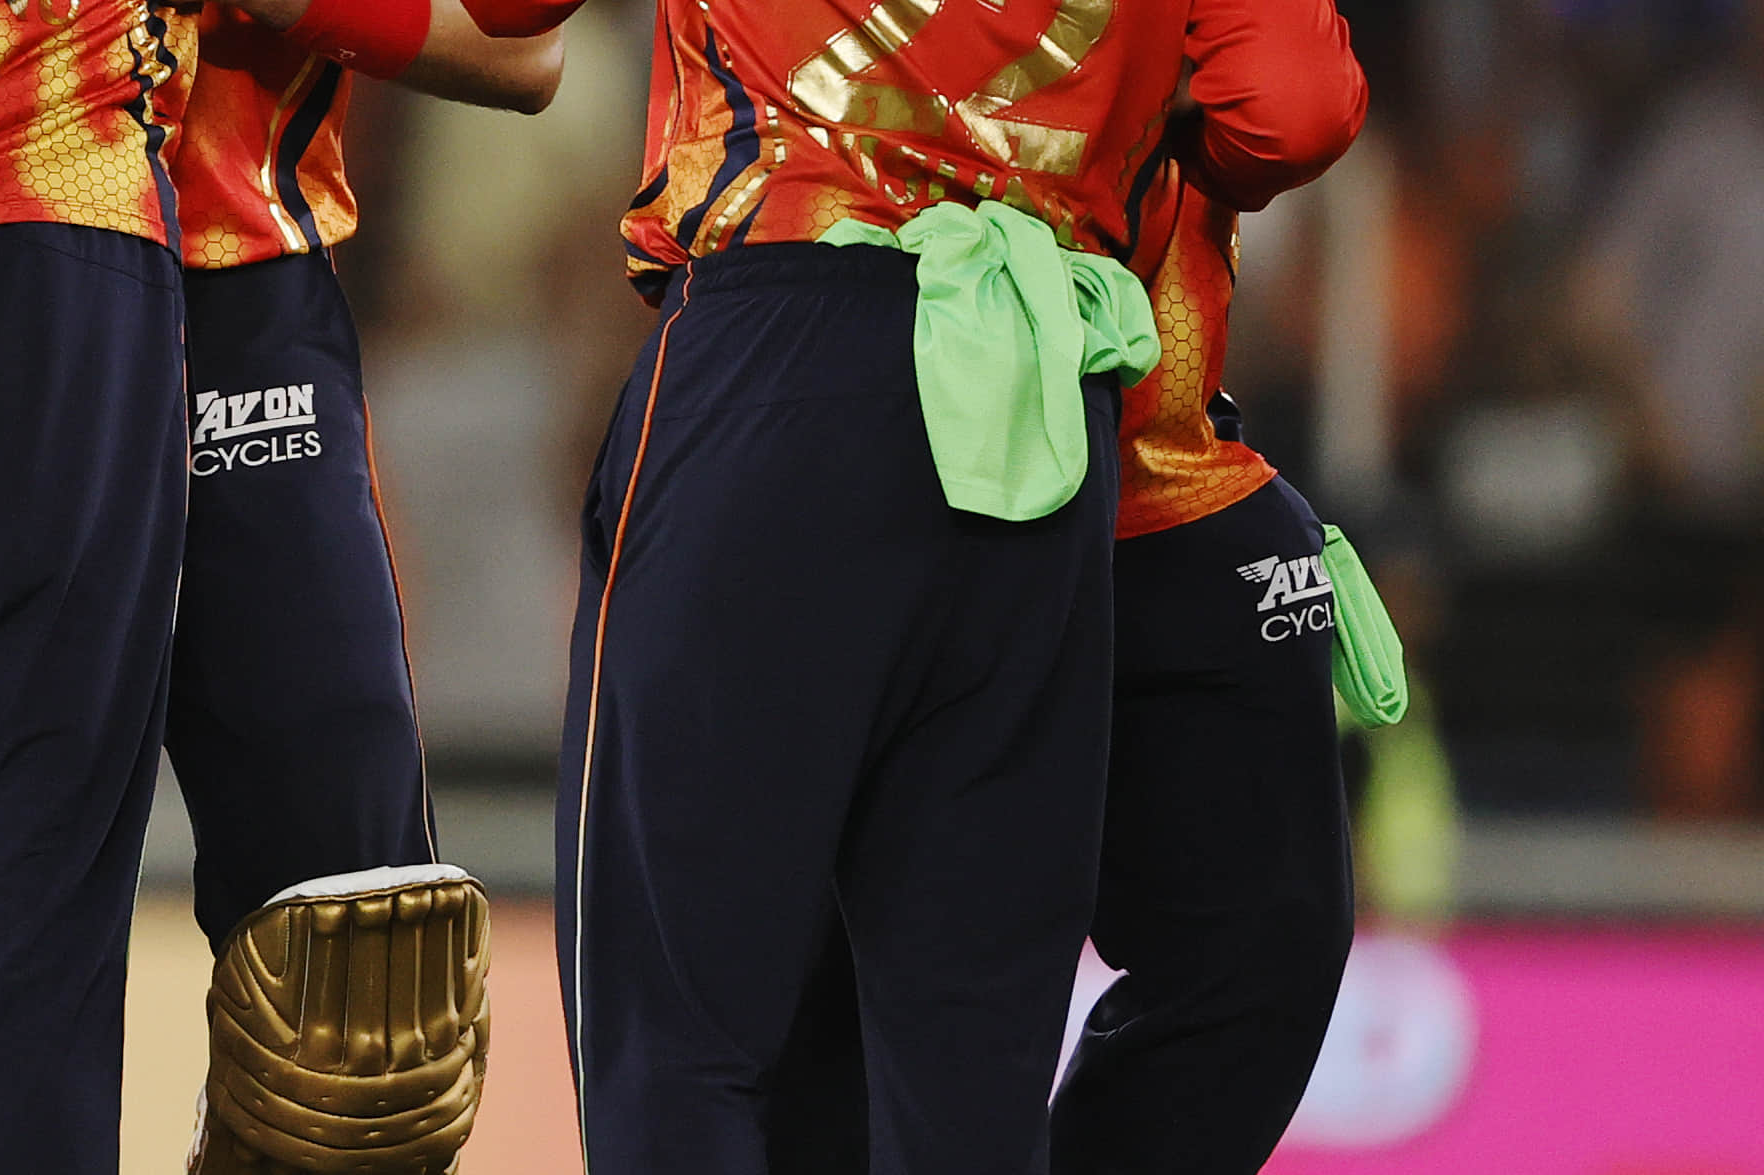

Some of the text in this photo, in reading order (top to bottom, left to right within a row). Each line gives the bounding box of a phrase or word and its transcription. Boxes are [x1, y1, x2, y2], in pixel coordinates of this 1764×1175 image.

[192, 383, 317, 445] AVON
[191, 429, 322, 477] CYCLES
[1260, 602, 1335, 642] CYCL
